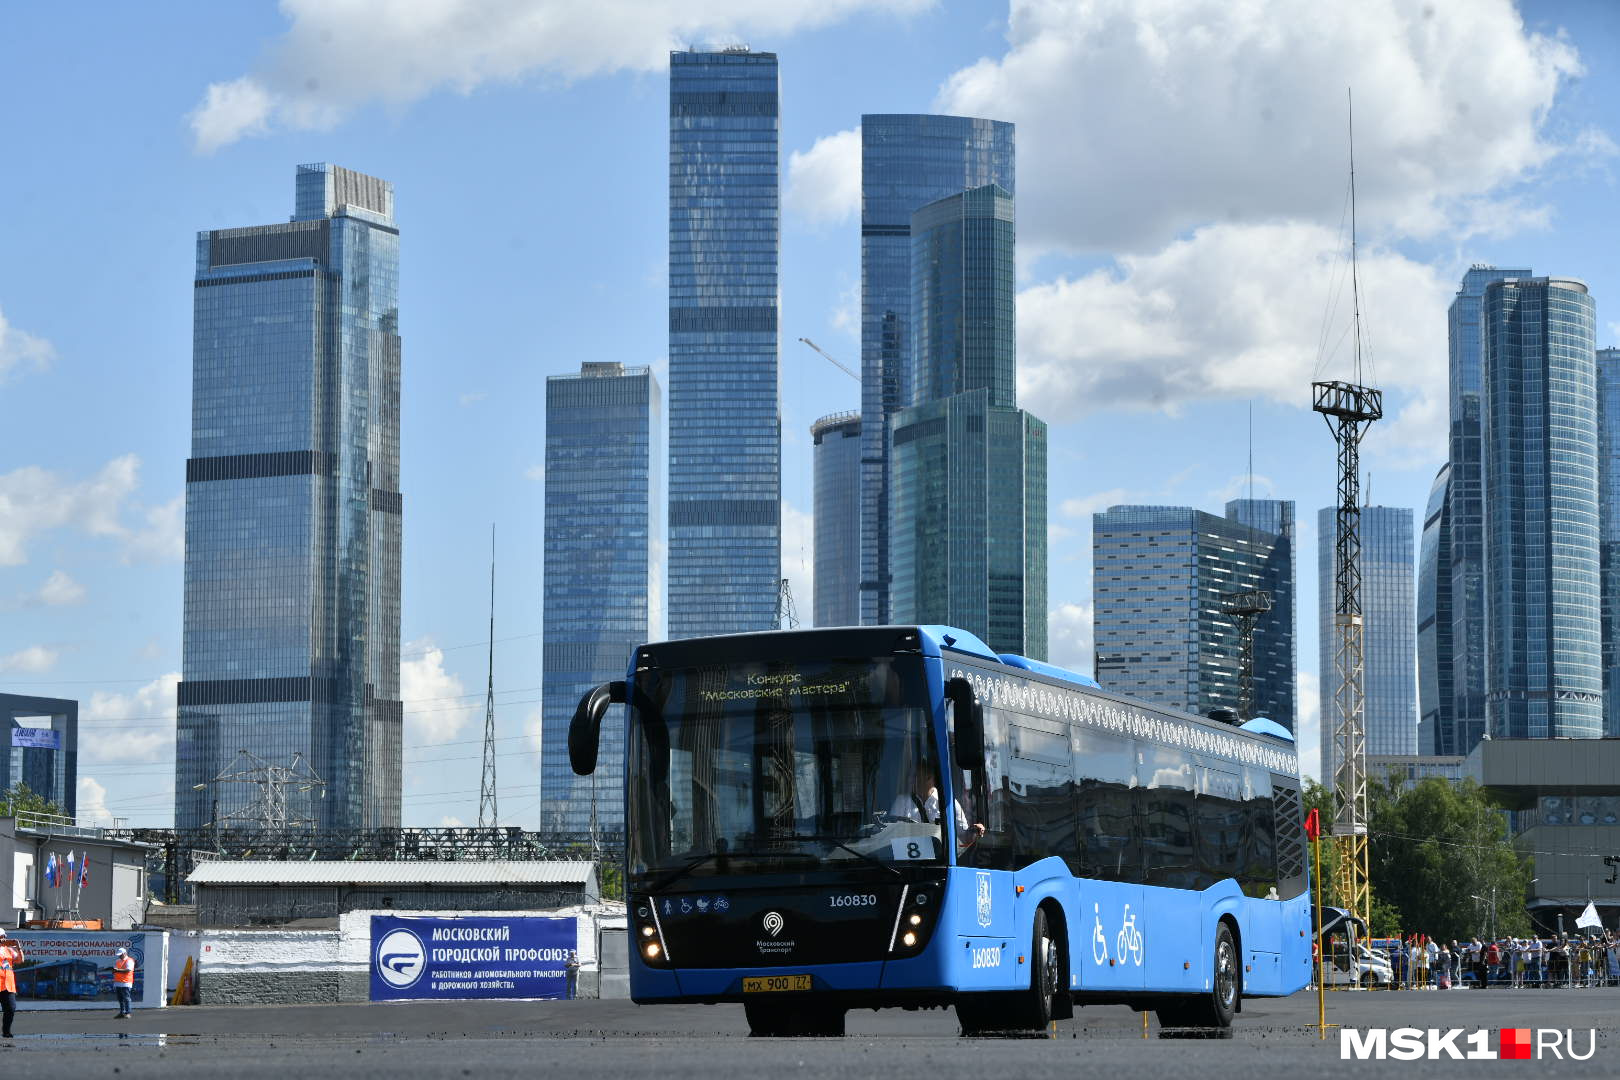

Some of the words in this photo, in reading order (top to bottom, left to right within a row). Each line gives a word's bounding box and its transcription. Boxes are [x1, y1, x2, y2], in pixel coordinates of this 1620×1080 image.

[747, 673, 801, 686] Конкурс
[907, 842, 921, 858] 8
[829, 894, 877, 907] 160830
[432, 926, 510, 941] МОСКОВСКИЙ
[40, 940, 131, 948] ПРОФЕССИОНАЛЬНОГО
[756, 939, 795, 948] Московский
[71, 948, 116, 957] ВОДИТЕЛЕЙ
[432, 946, 500, 963] ГОРОДСКОЙ
[505, 947, 569, 961] ПРОФСОЮЗ
[972, 947, 1001, 969] 160830
[432, 970, 472, 978] РАБОТНИКОВ
[474, 970, 532, 978] АВТОМОБИЛЬНОГО
[533, 970, 566, 978] ТРАНСПОРТ
[431, 981, 437, 990] И
[438, 981, 478, 991] ДОРОЖНОГО
[479, 980, 515, 989] ХОЗЯЙСТВА
[767, 978, 789, 990] 900
